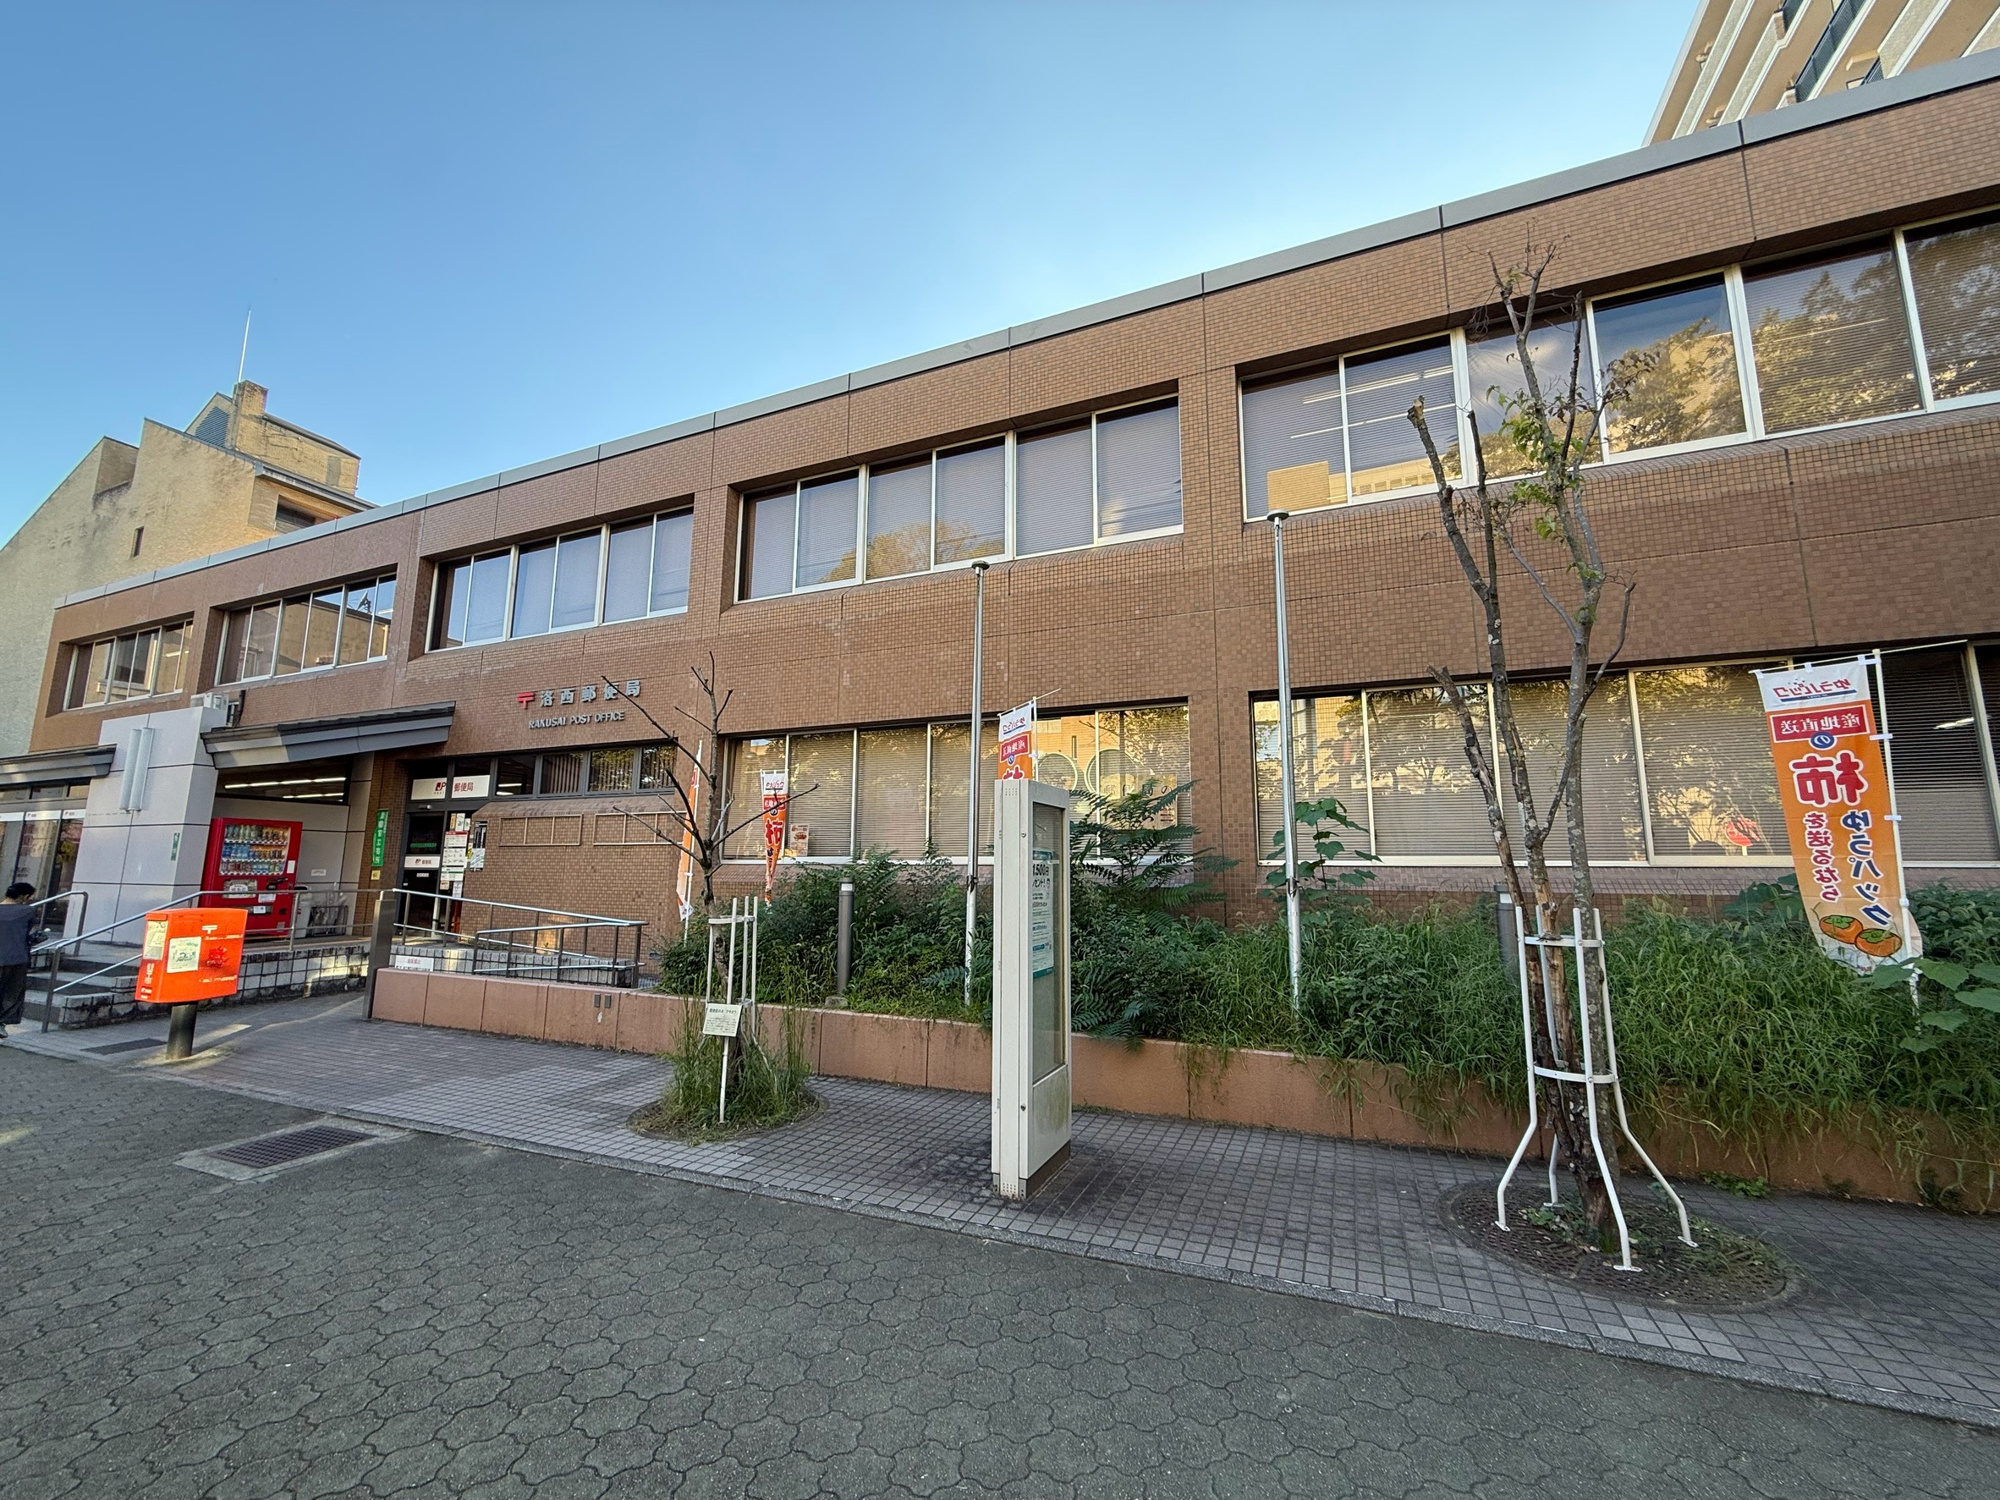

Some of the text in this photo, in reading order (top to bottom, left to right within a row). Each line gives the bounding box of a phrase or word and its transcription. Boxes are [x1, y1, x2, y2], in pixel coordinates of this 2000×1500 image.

[540, 680, 640, 706] 洛西郵便局
[528, 711, 625, 729] RAKUSAI POST OFFICE
[454, 781, 474, 792] 郵便局
